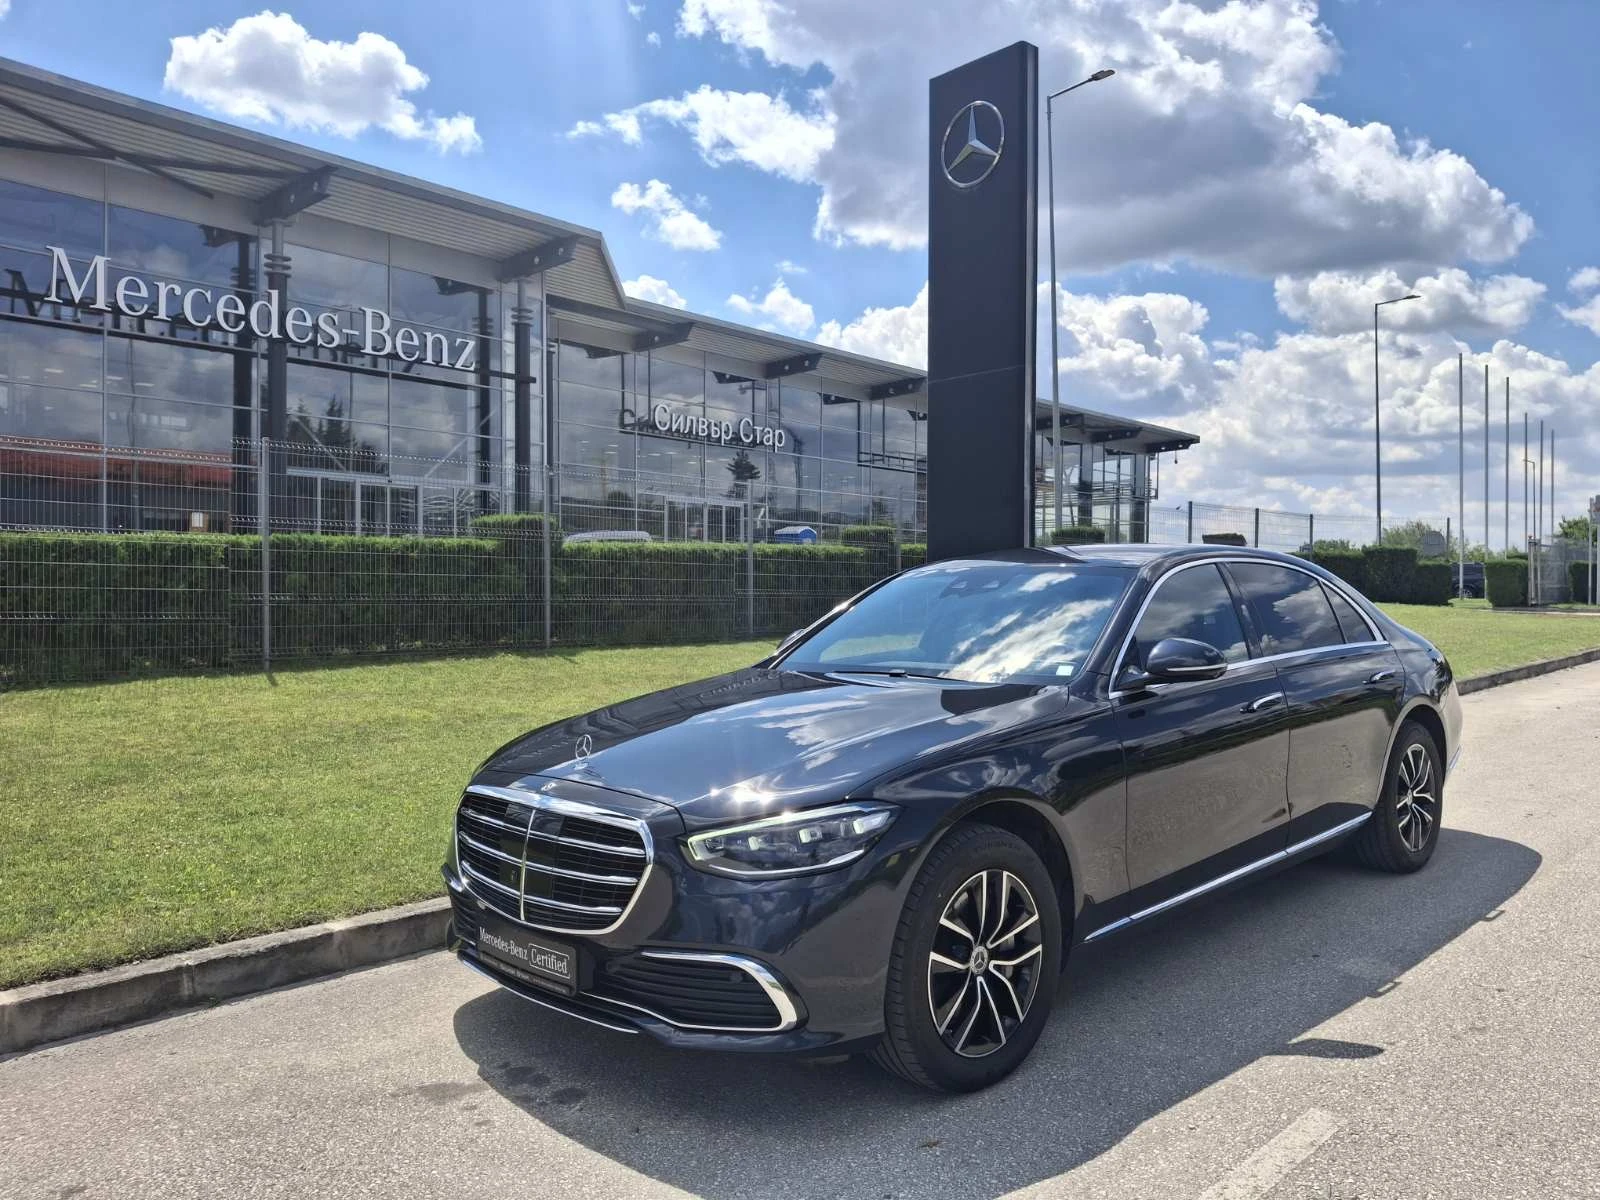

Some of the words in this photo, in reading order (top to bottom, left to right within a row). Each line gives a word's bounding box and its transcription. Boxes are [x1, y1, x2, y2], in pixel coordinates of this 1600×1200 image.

[44, 245, 477, 372] Mercedes-Benz
[654, 403, 733, 446] Силвър
[740, 418, 785, 453] Стар
[479, 927, 528, 960] Mercedes-Benz
[531, 948, 568, 974] Certified
